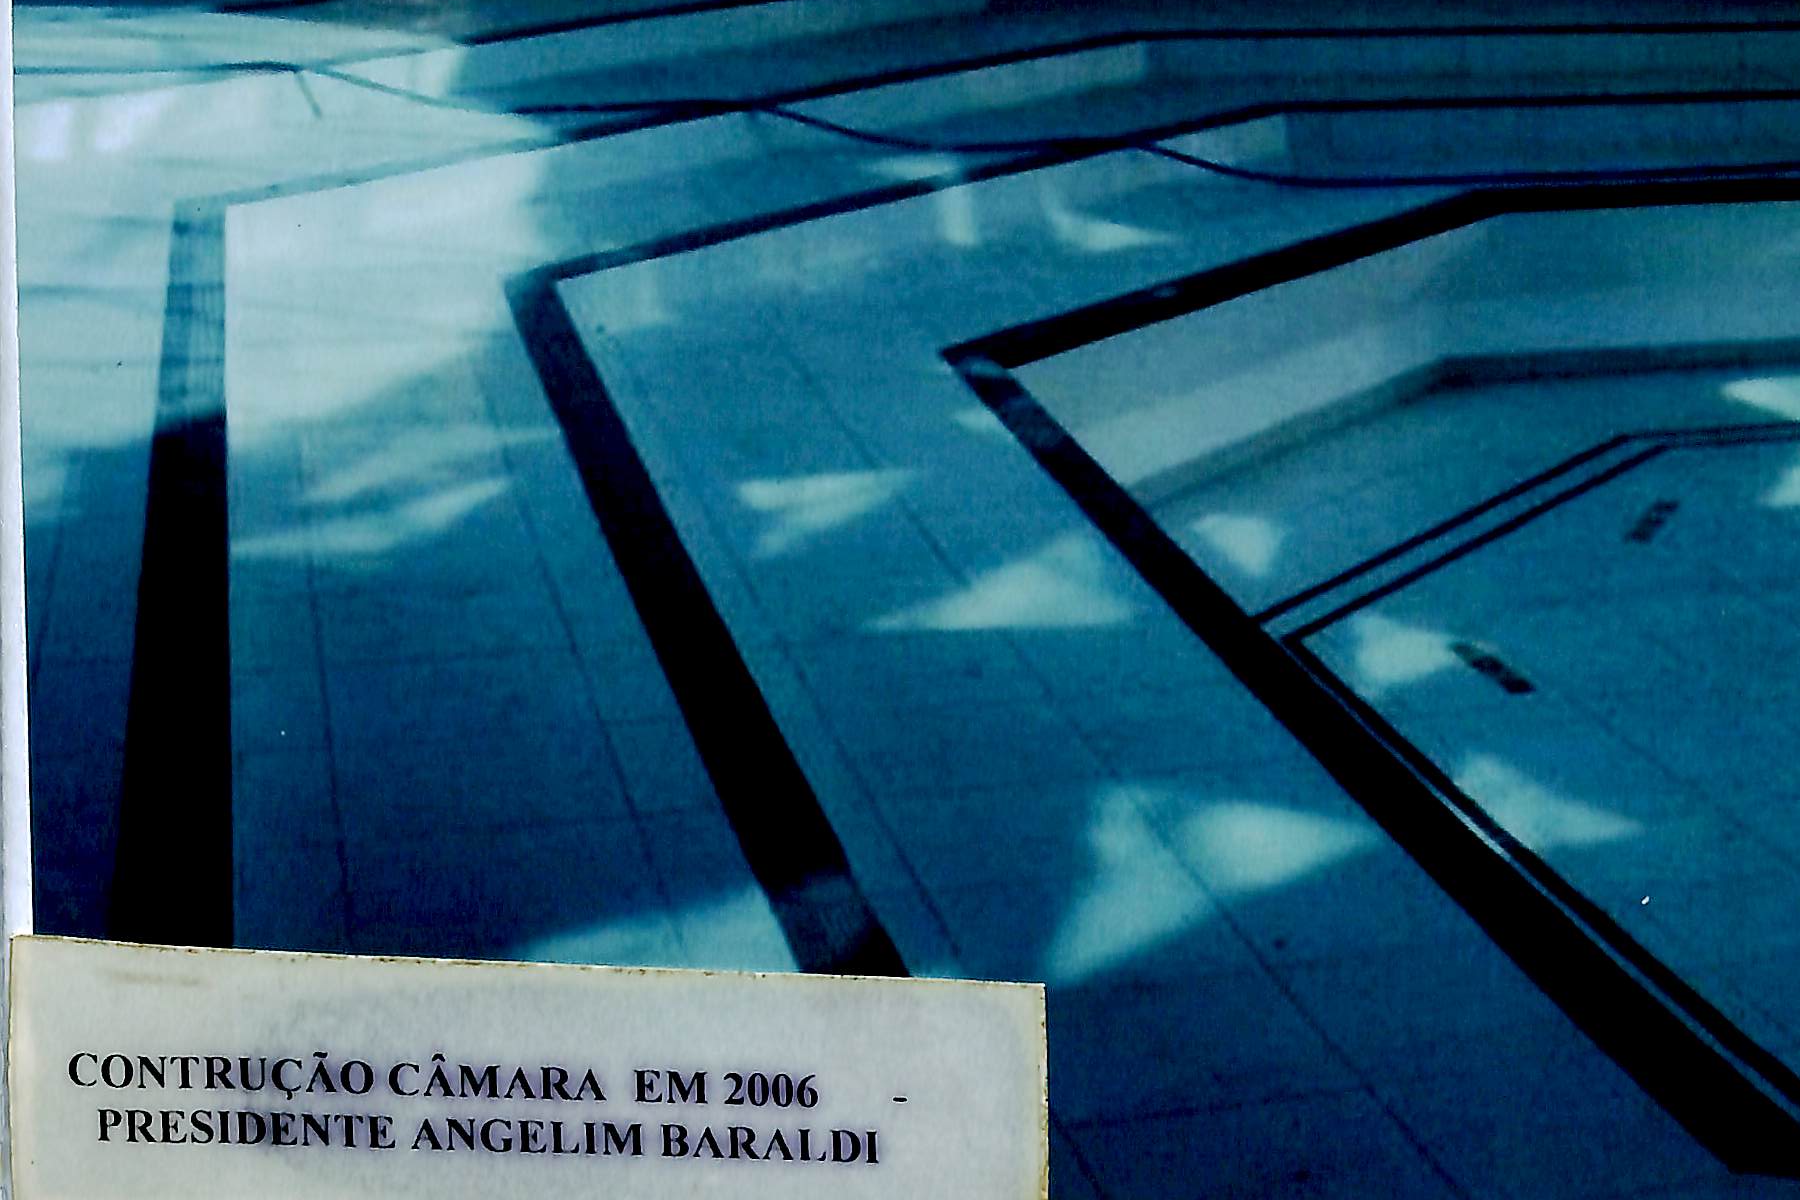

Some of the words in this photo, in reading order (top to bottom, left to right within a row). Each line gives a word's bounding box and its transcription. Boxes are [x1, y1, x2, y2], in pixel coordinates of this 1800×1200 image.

[67, 1051, 376, 1101] CONTRUÇÃO
[388, 1052, 608, 1102] CÂMARA
[633, 1068, 709, 1105] EM
[723, 1071, 820, 1109] 2006
[97, 1108, 397, 1152] PRESIDENTE
[410, 1116, 645, 1157] ANGELIM
[659, 1122, 880, 1165] BARALDI
